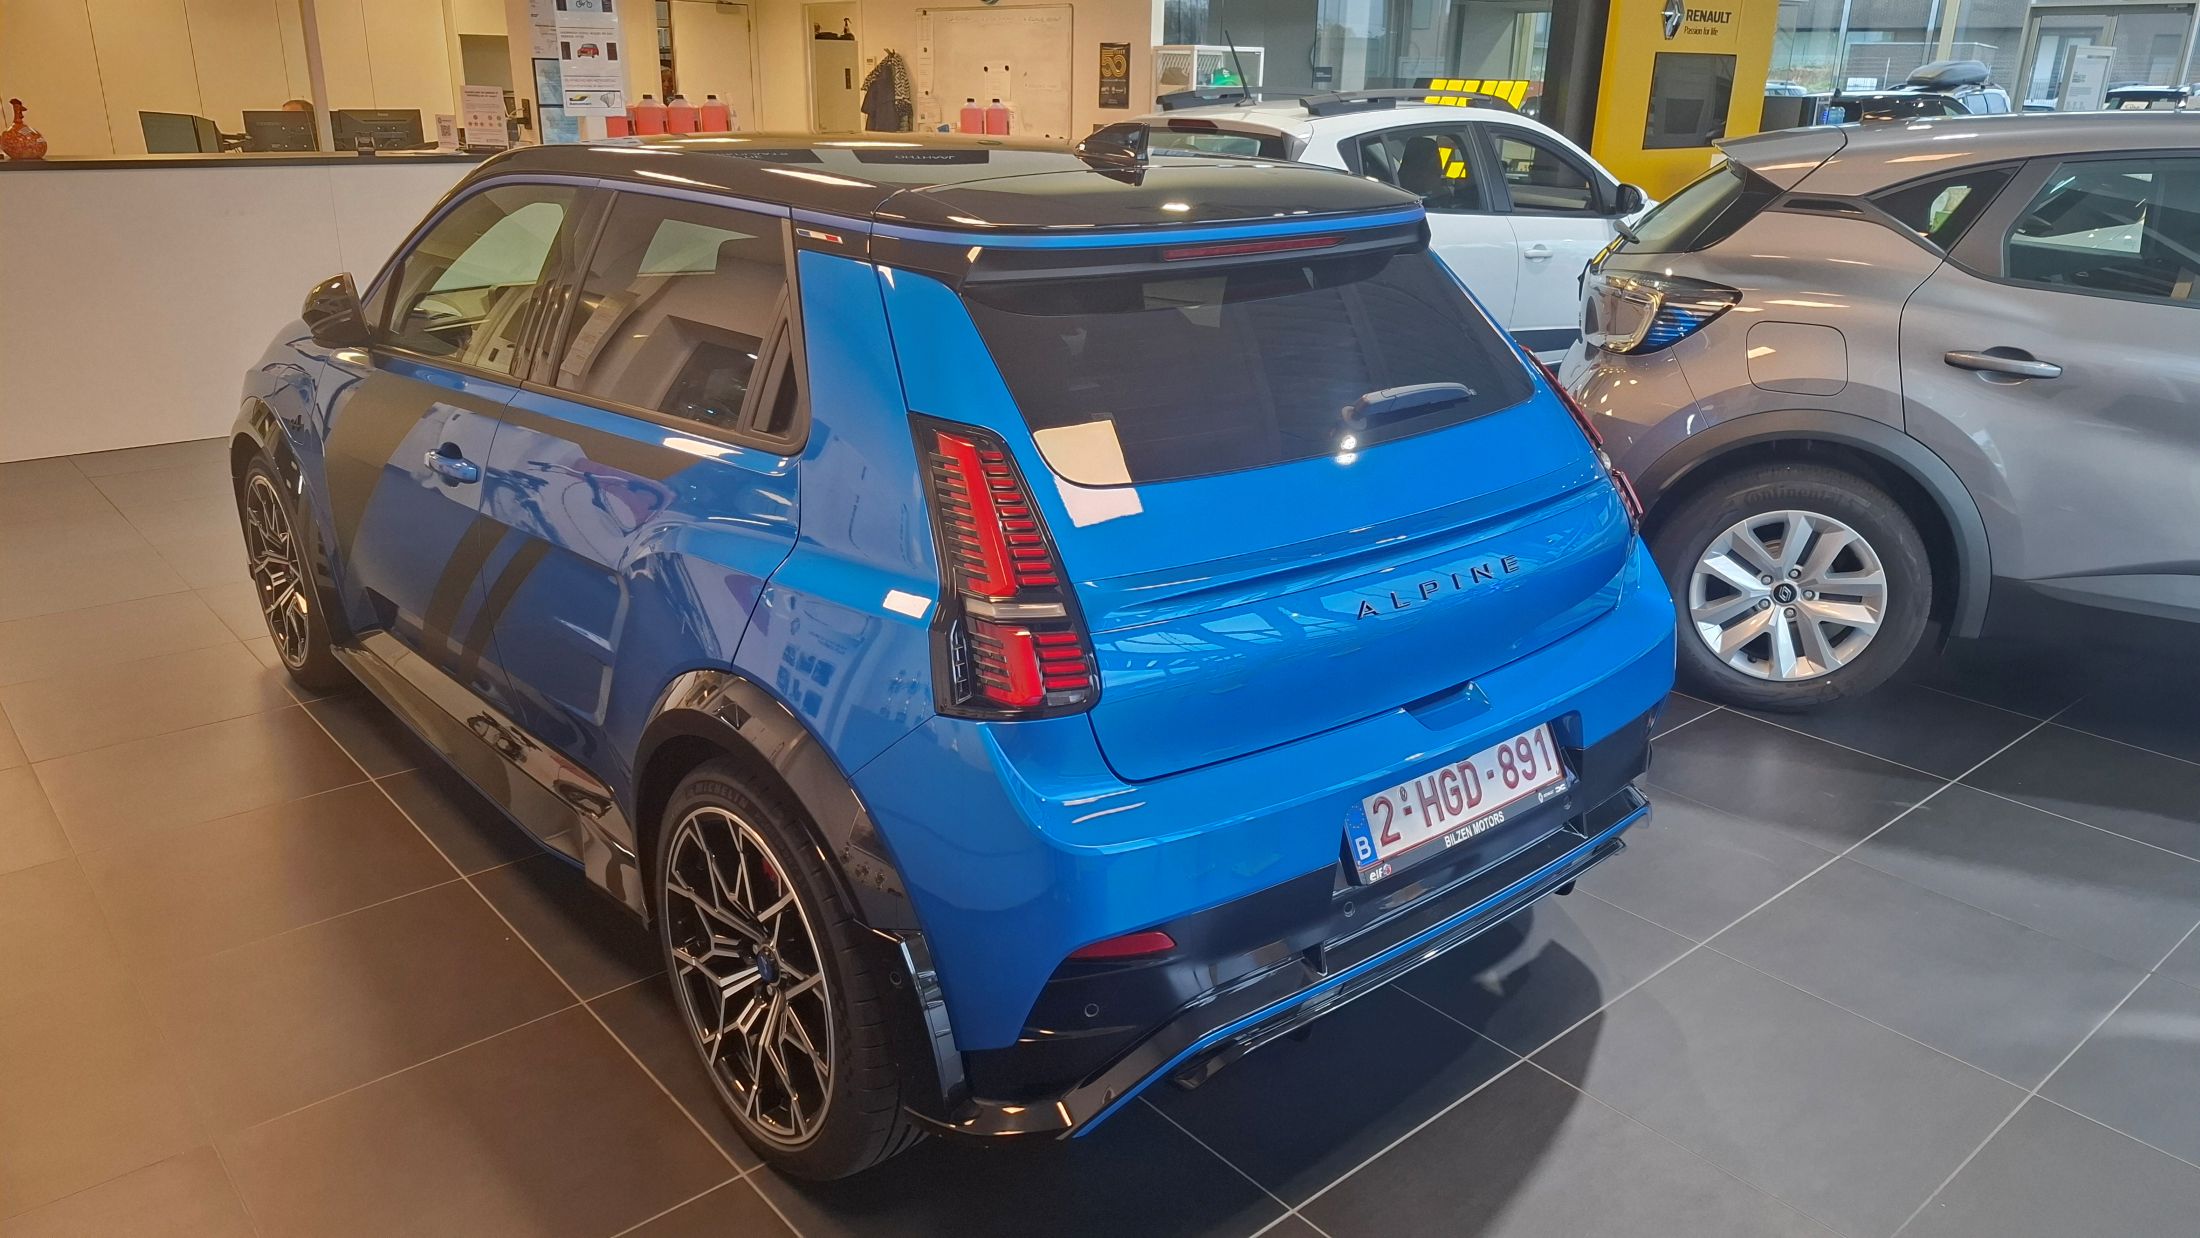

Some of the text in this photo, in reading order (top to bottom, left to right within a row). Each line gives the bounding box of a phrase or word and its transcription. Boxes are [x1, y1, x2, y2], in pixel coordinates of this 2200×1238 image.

[1686, 9, 1732, 24] RENAULT
[1684, 26, 1702, 35] Passion
[1711, 27, 1719, 36] life
[1357, 555, 1519, 620] ALPINE
[695, 781, 749, 809] MICHELIN
[1445, 811, 1505, 848] BILZEN MOTORS
[1355, 836, 1372, 860] B
[1369, 867, 1384, 881] elf
